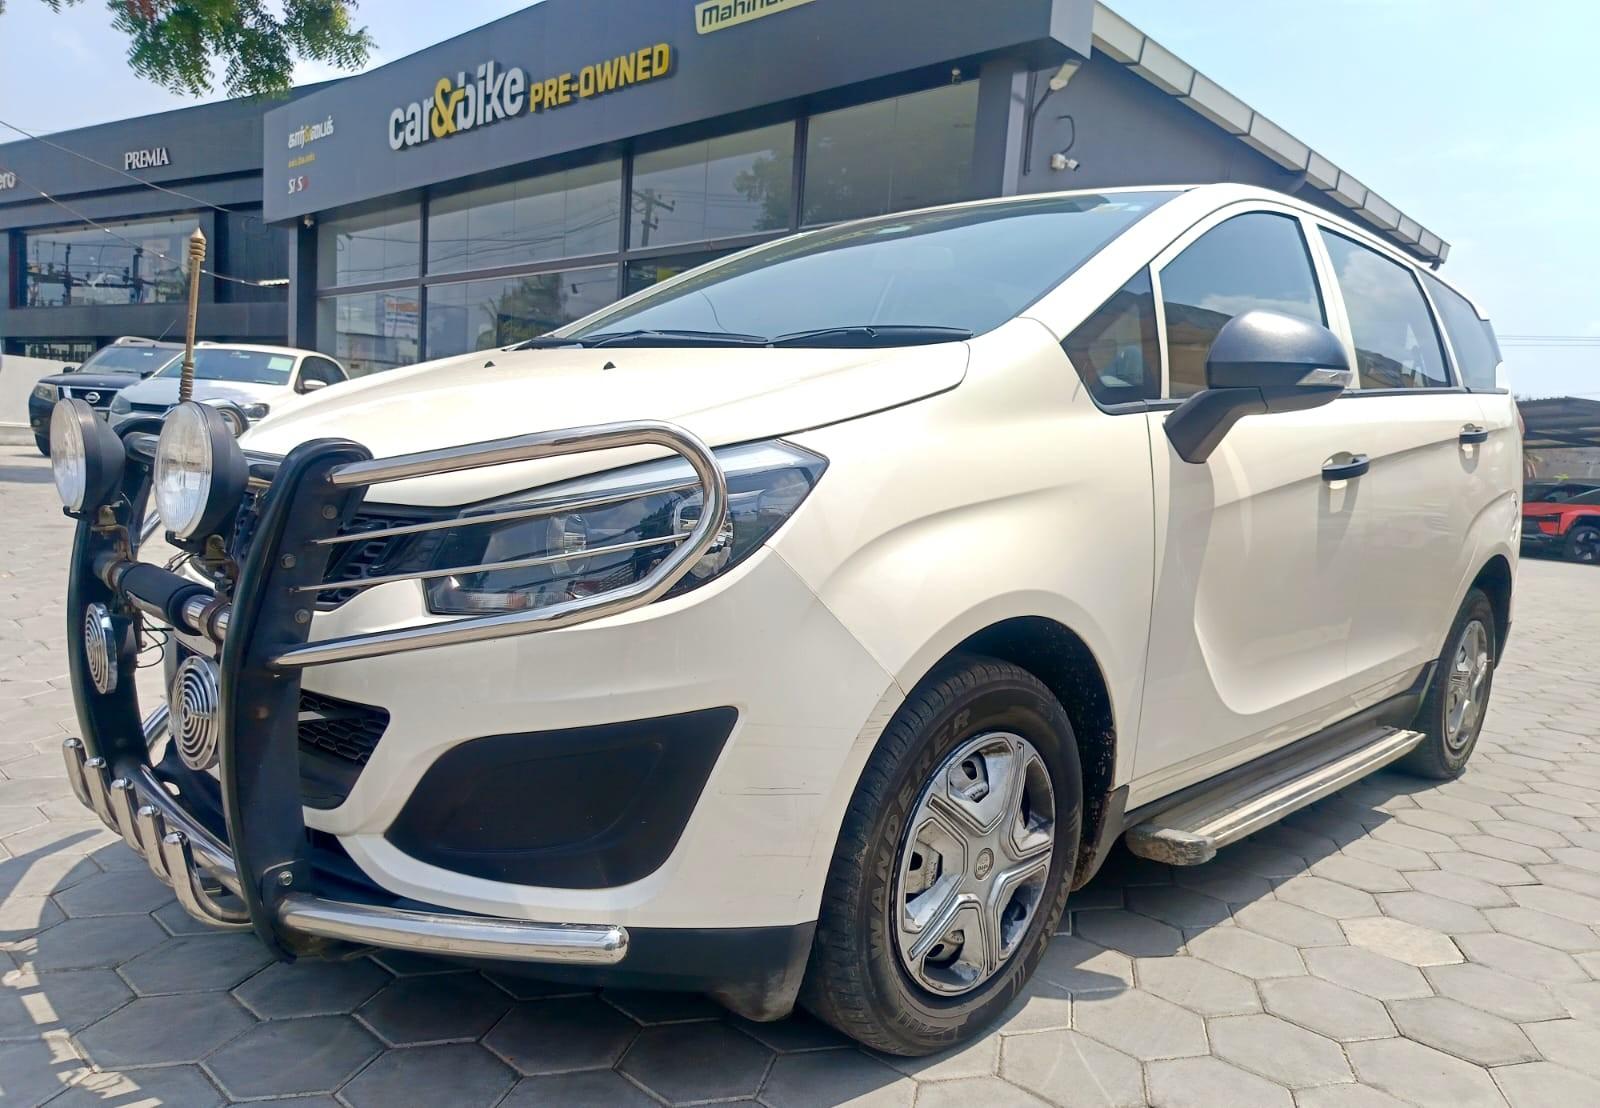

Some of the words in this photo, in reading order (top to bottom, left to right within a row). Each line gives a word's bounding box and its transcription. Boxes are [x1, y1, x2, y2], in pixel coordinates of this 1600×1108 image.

[701, 0, 784, 27] Mahin
[388, 60, 525, 150] car&bike
[529, 42, 670, 113] PRE-OWNED
[124, 147, 169, 170] PREMIA
